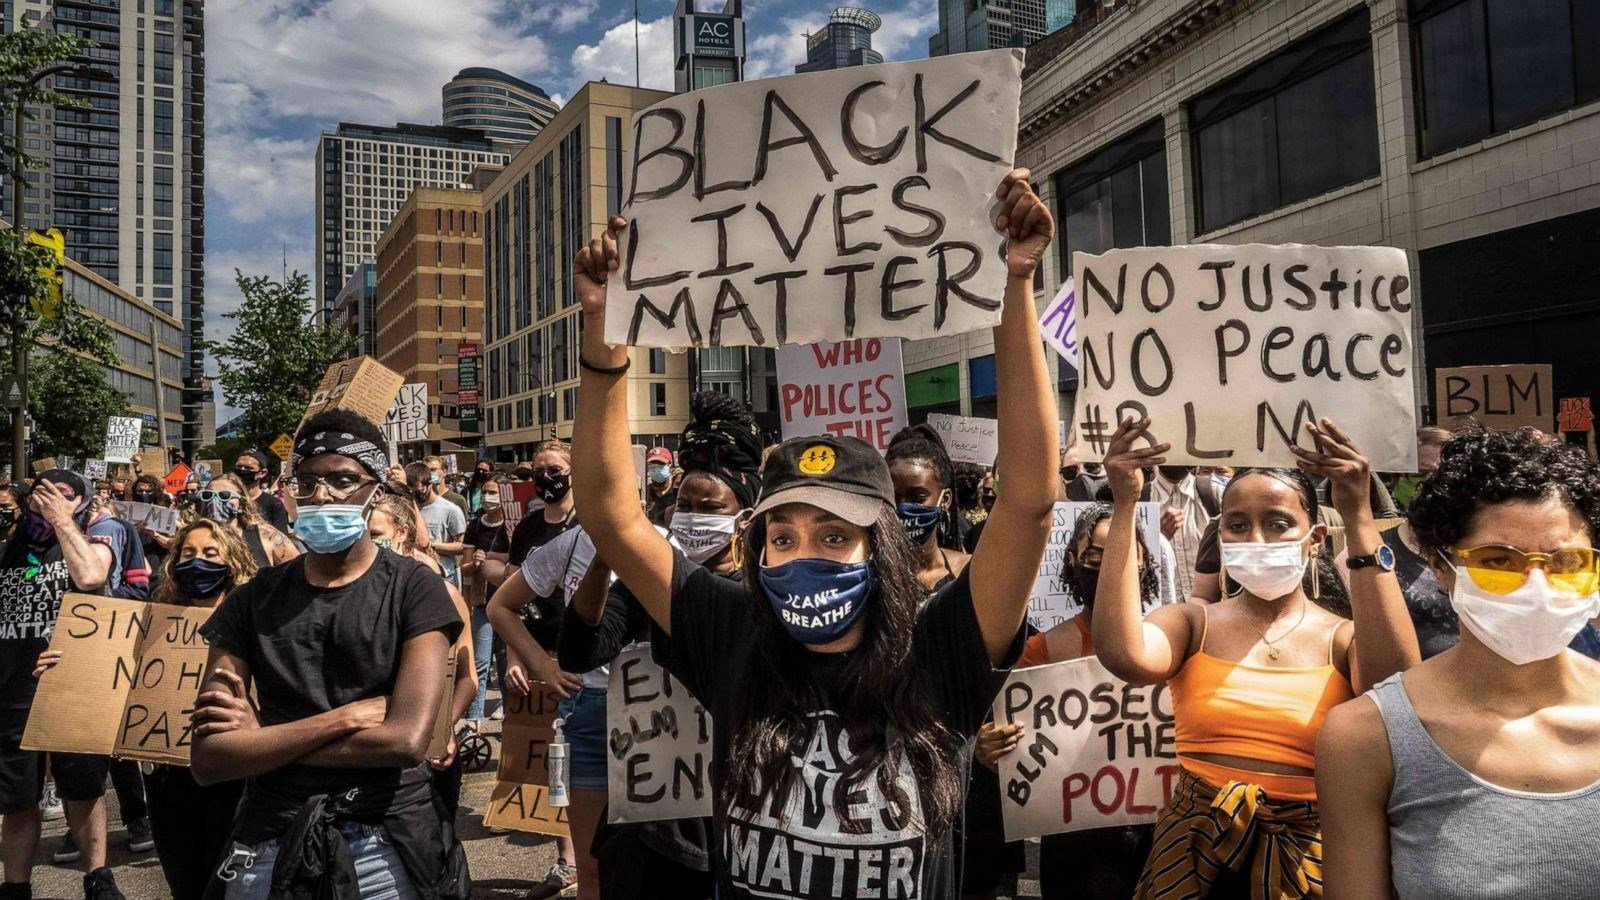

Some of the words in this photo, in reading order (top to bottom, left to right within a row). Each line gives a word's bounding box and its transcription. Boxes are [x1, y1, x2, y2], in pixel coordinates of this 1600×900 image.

[699, 21, 729, 37] AC
[620, 72, 1008, 212] BLACK
[624, 175, 947, 291] LIVES
[626, 240, 1001, 346] MATTER
[1083, 262, 1175, 318] NO
[811, 337, 882, 369] WHO
[1083, 326, 1175, 397] NO
[1214, 318, 1407, 386] Peace
[781, 374, 894, 422] POLICES
[1445, 372, 1542, 418] BLM
[108, 427, 138, 436] LIVES
[109, 417, 135, 427] BLACK
[826, 416, 893, 450] THE
[936, 421, 951, 431] NO
[1567, 411, 1584, 429] 12
[106, 435, 137, 447] MATTER
[499, 483, 514, 502] DO
[501, 501, 522, 520] YOU
[781, 600, 852, 628] BREATHE
[791, 588, 839, 609] CAN'T
[68, 603, 153, 640] SIN
[112, 656, 165, 691] NO
[121, 704, 194, 748] PAZ
[610, 705, 679, 761] BLM
[1099, 721, 1177, 761] THE
[627, 752, 713, 804] EN
[1007, 732, 1059, 808] BLM
[730, 823, 930, 899] MATTER
